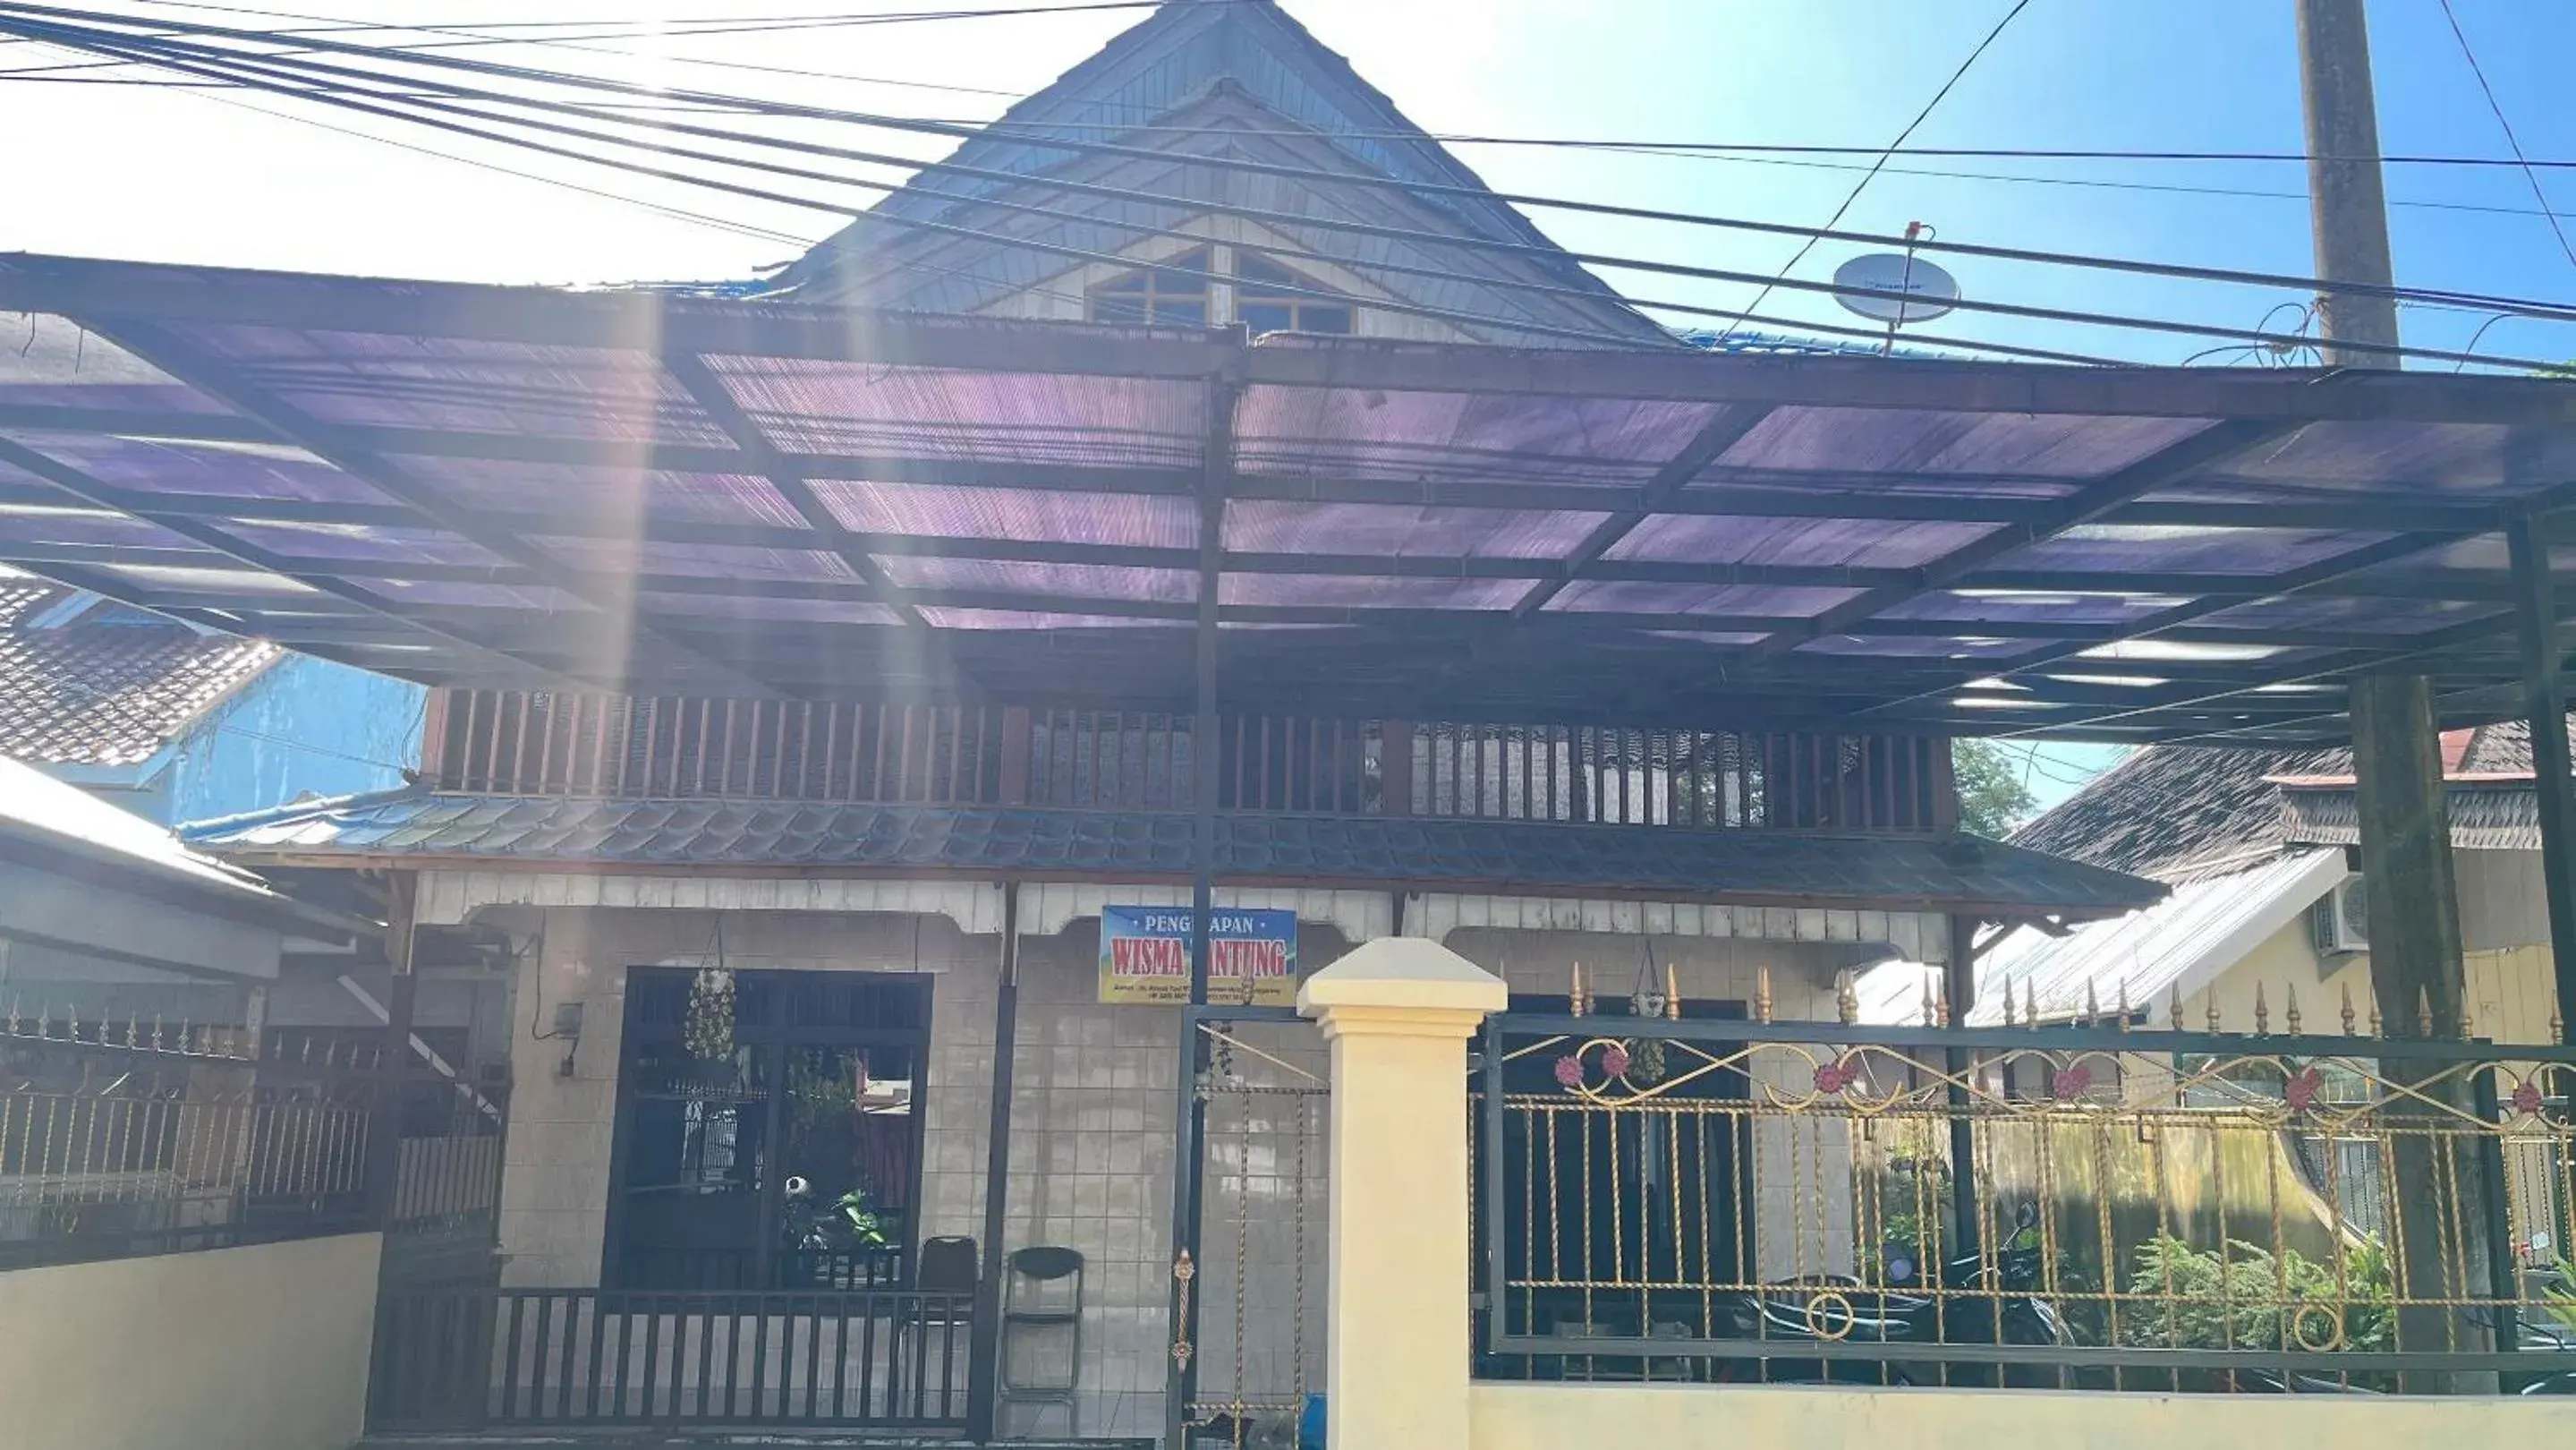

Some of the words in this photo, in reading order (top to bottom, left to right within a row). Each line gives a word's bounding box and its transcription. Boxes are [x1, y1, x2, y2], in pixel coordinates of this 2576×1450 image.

[1144, 915, 1254, 934] PENGAPAN
[1110, 937, 1185, 977] WISMA
[1190, 938, 1287, 978] ANTUNG
